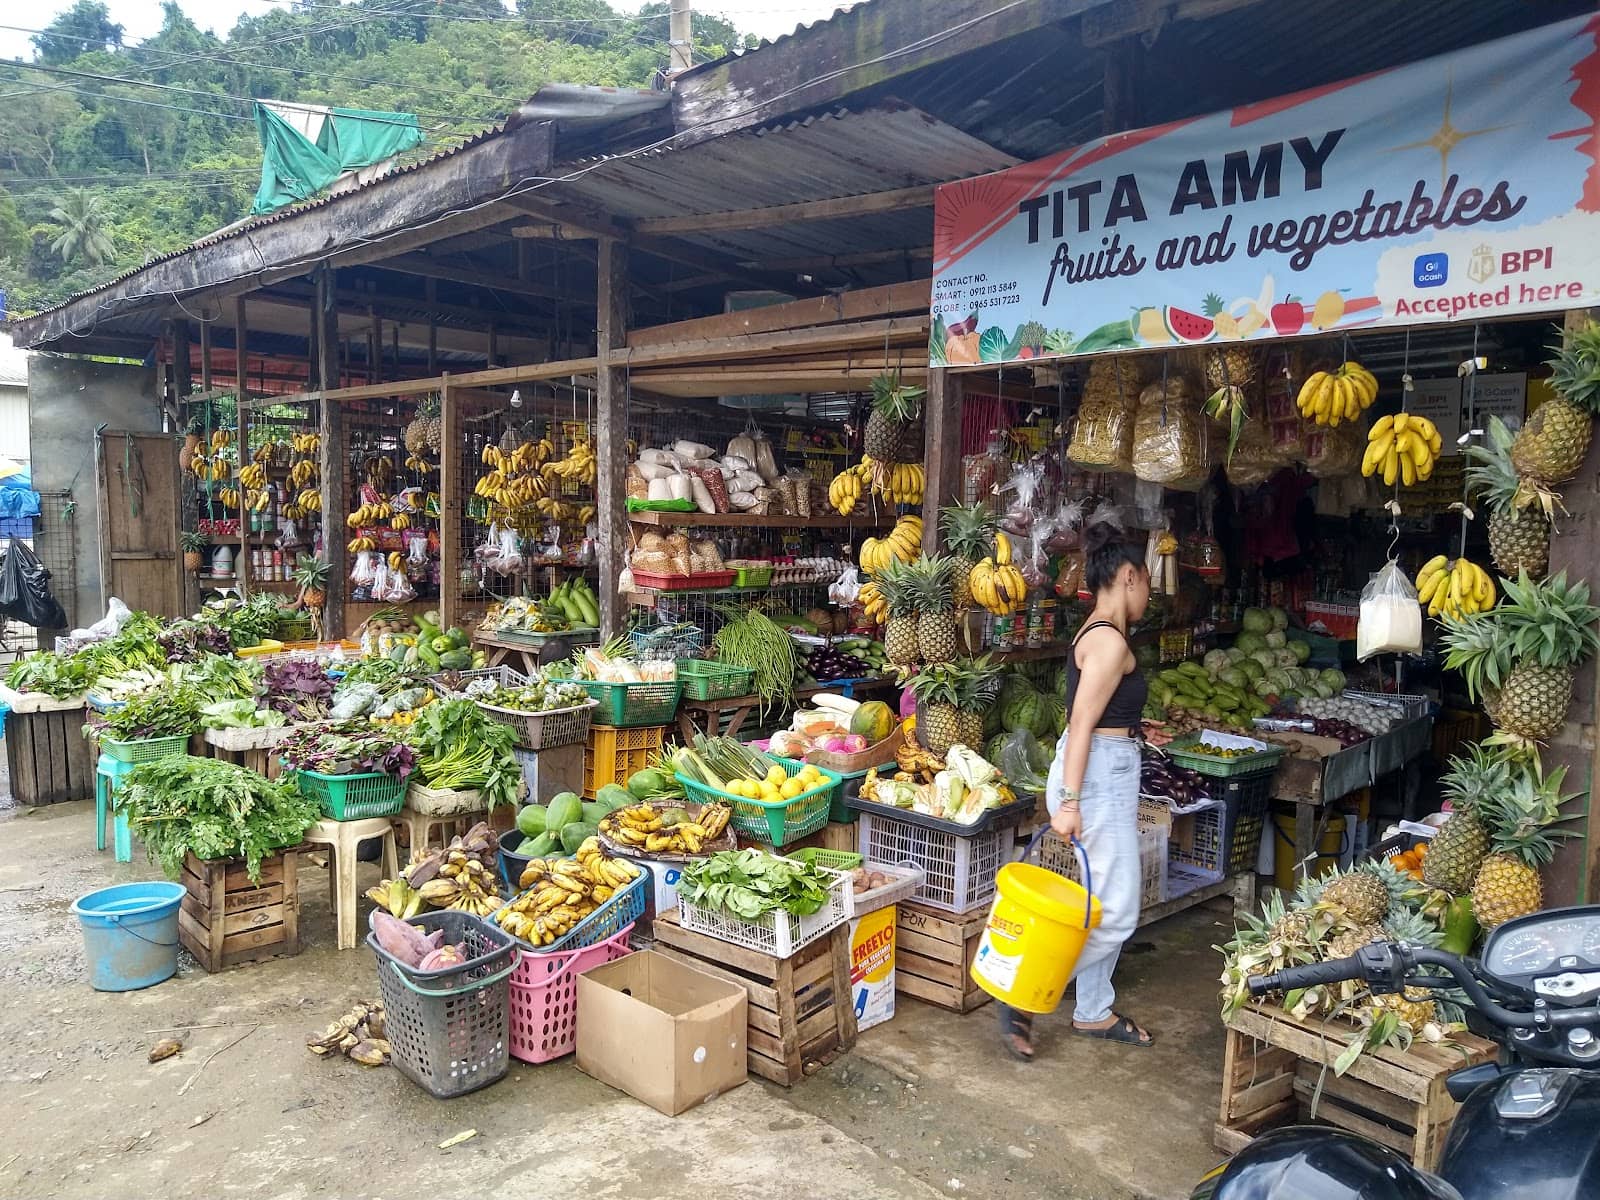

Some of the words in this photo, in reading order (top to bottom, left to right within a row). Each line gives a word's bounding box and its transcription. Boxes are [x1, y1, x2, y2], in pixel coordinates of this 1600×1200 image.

[1019, 173, 1148, 244] TITA
[1169, 128, 1347, 216] AMY
[1042, 233, 1146, 306] fruits
[1155, 214, 1236, 271] and
[1247, 174, 1528, 272] vegetables
[1501, 246, 1553, 275] BPI
[935, 290, 961, 301] SMART
[969, 286, 986, 297] 0912
[987, 285, 997, 294] 113
[999, 281, 1017, 292] 5849
[936, 275, 973, 289] CONTACT
[974, 273, 988, 283] NO.
[1418, 273, 1443, 282] GCash
[933, 303, 960, 314] GLOBE
[969, 299, 988, 310] 0965
[989, 297, 1001, 307] 531
[1002, 294, 1020, 305] 7223
[1394, 285, 1510, 317] Accepted
[1519, 281, 1583, 304] here
[853, 925, 894, 964] FREETO
